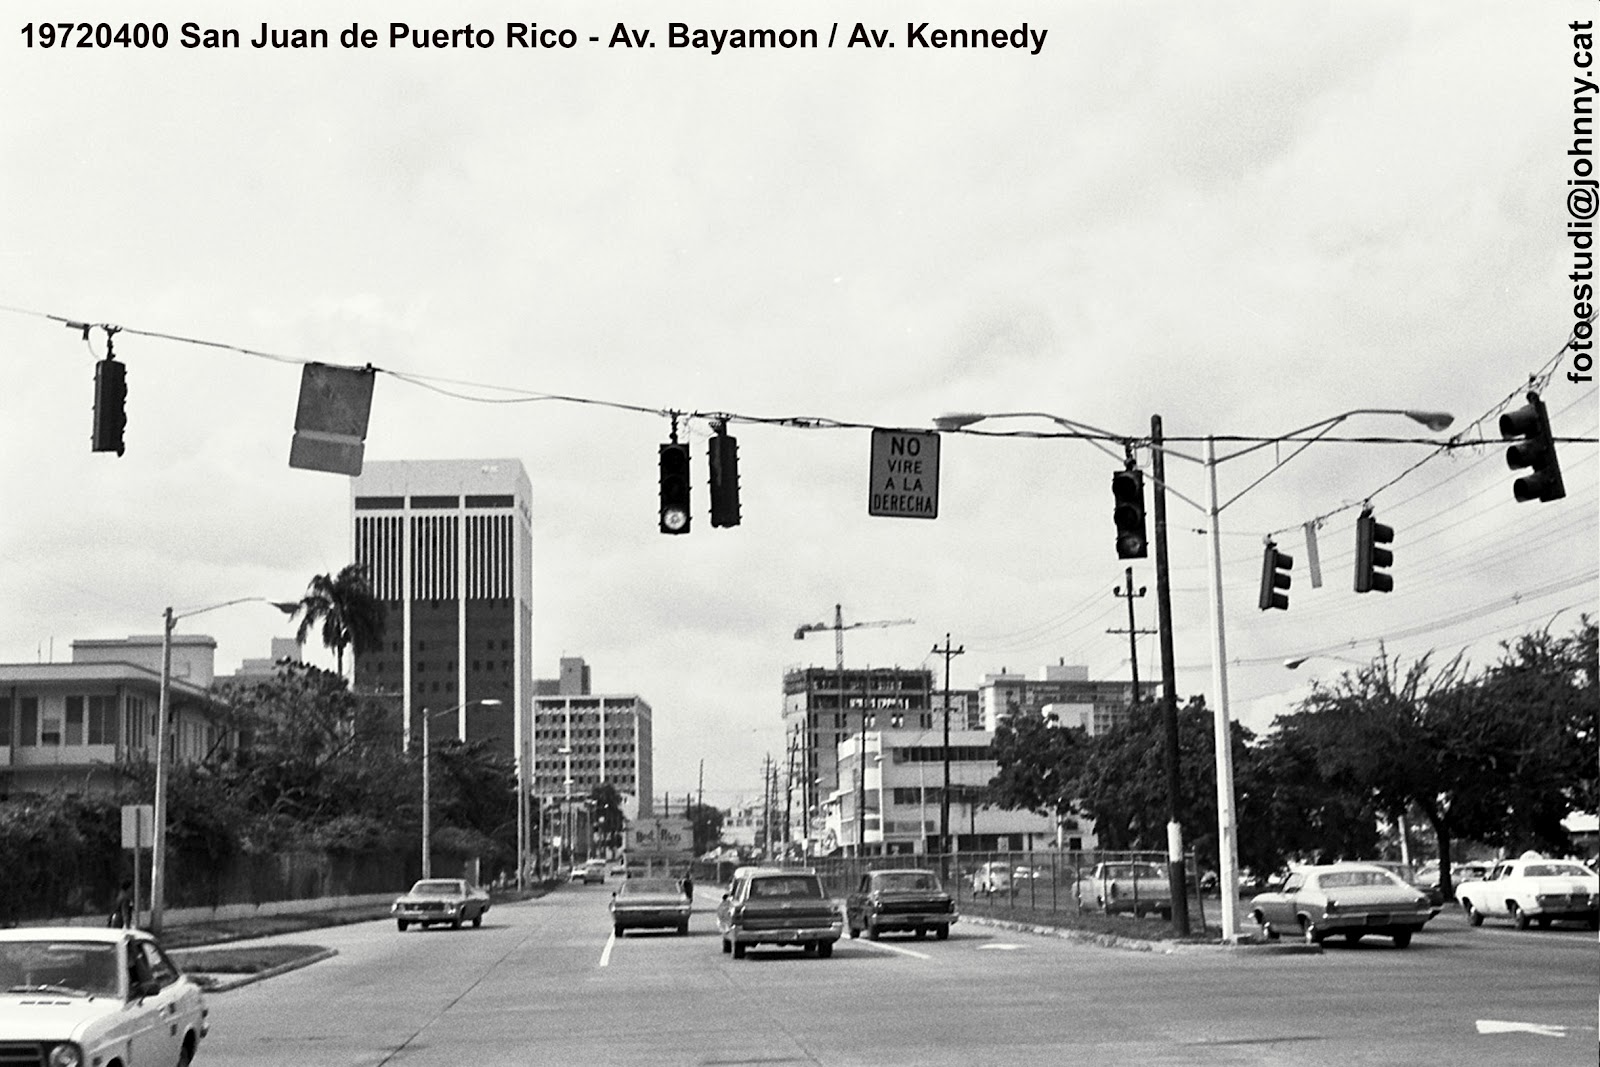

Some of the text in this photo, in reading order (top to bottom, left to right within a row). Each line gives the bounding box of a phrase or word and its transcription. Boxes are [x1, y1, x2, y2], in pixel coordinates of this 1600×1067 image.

[891, 436, 921, 456] NO
[887, 459, 923, 475] VIRE
[884, 476, 923, 492] A LA
[873, 494, 933, 513] DERECHA
